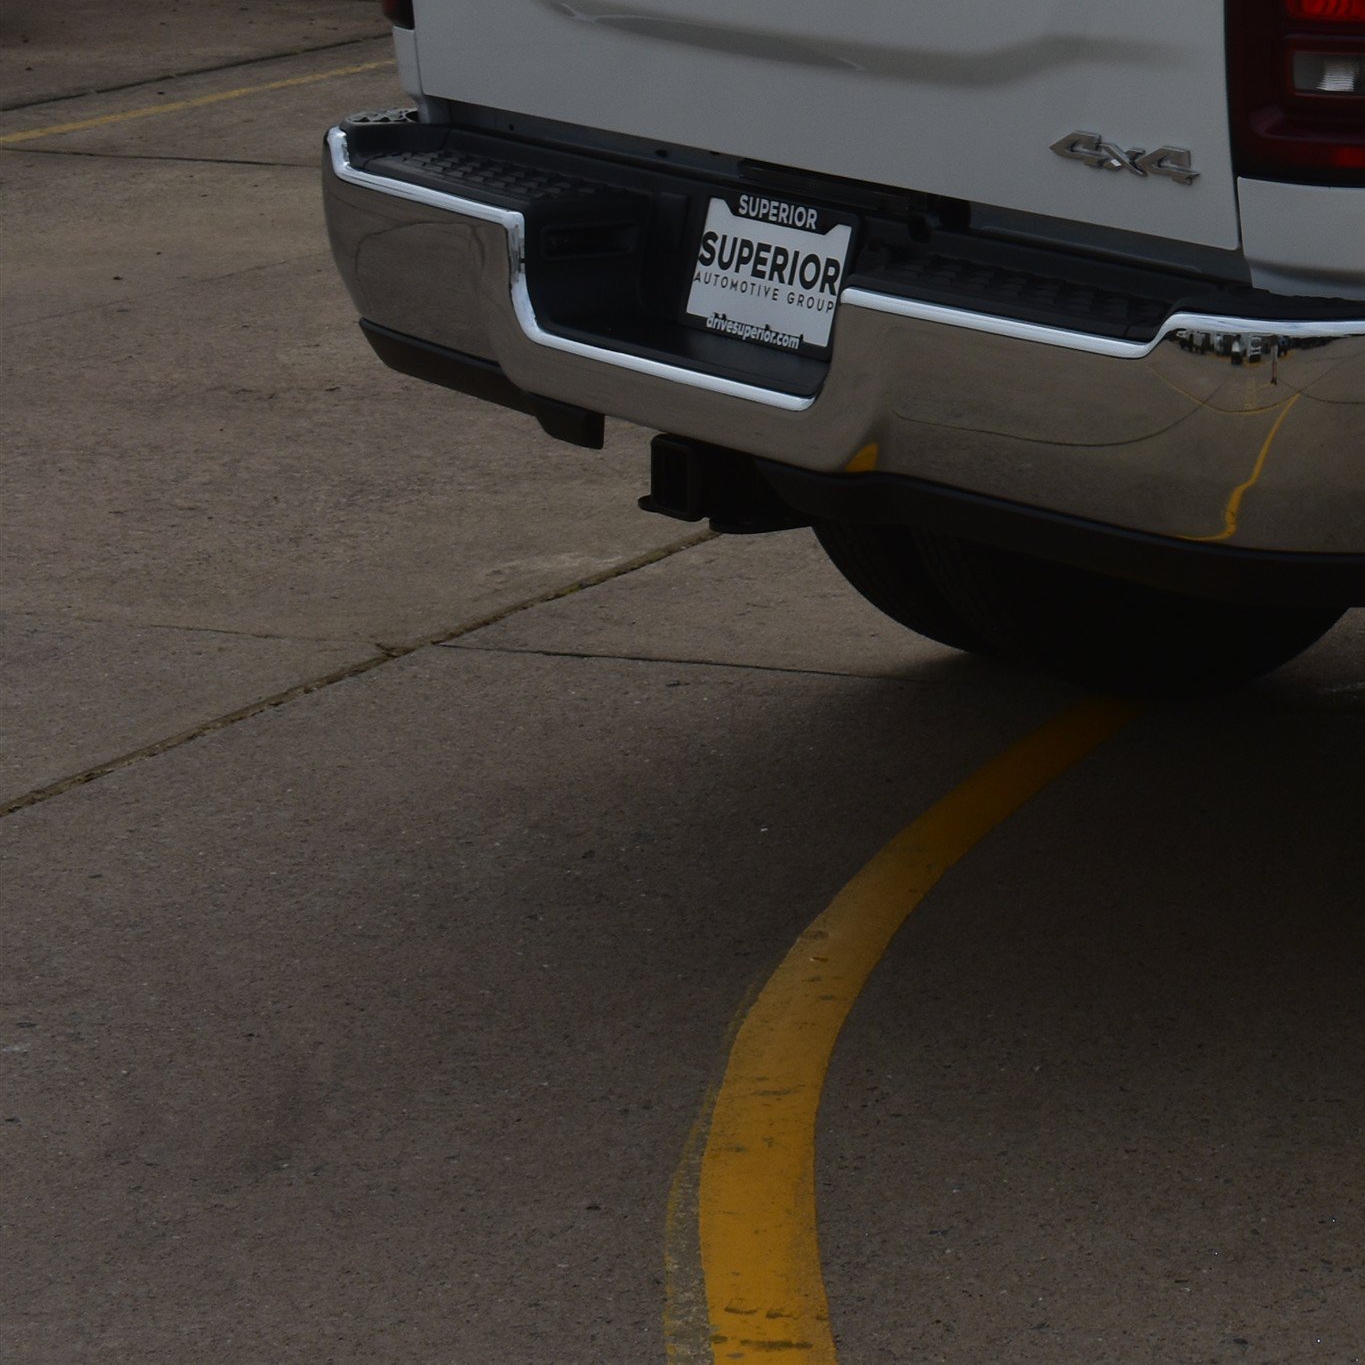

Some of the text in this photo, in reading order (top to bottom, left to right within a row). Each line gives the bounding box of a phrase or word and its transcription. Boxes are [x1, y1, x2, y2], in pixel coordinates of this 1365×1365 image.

[738, 194, 818, 230] SUPERIOR
[697, 231, 841, 296] SUPERIOR
[693, 270, 835, 313] AUTOMOTIVE GROUP
[706, 314, 800, 350] drivesuperior.com
